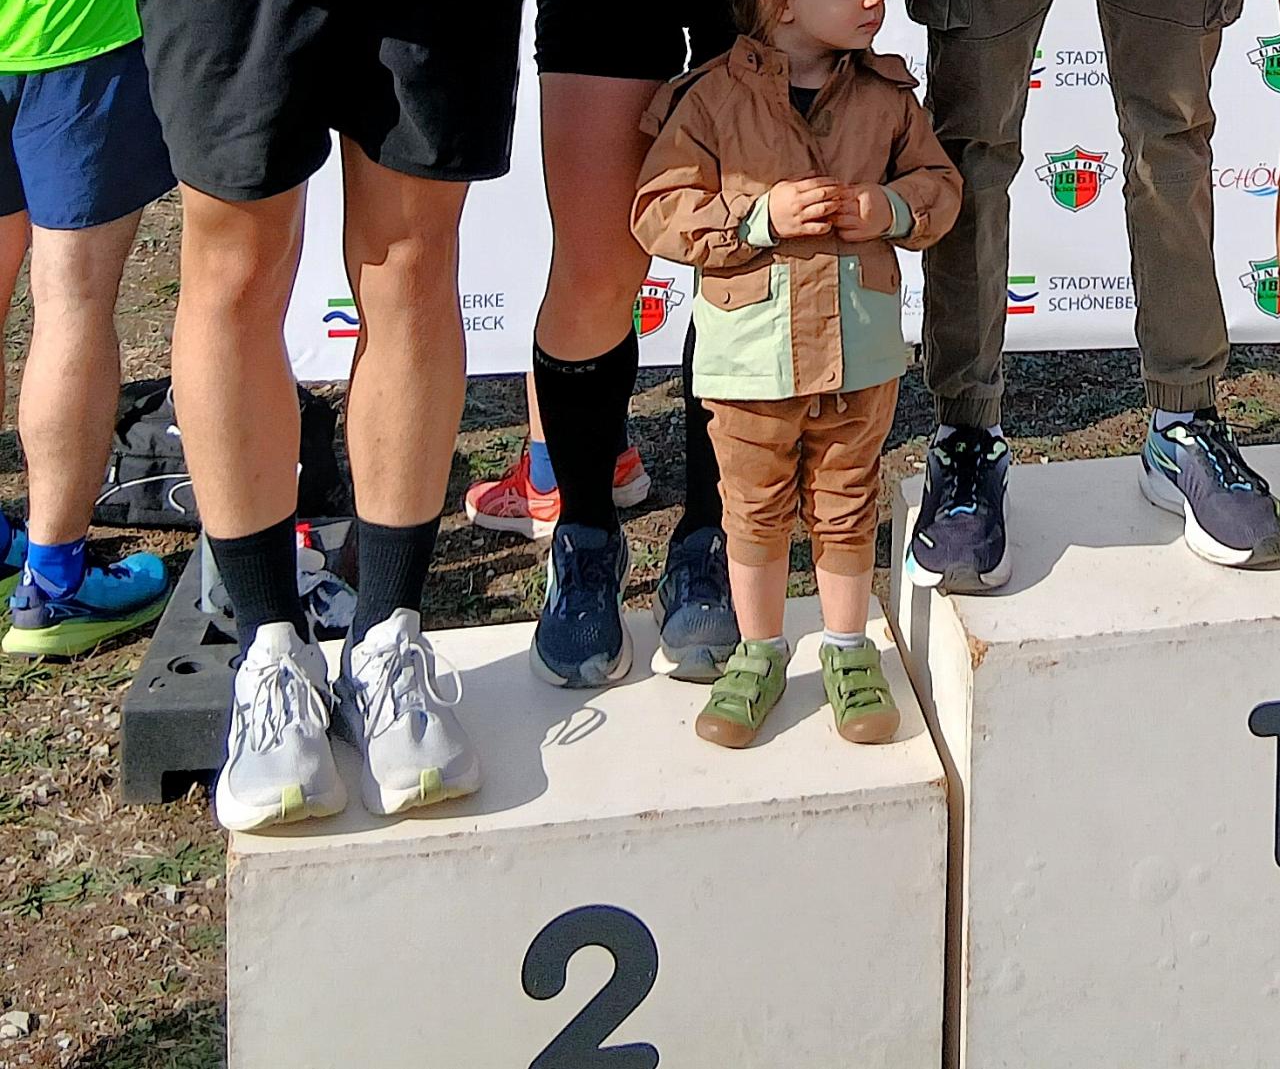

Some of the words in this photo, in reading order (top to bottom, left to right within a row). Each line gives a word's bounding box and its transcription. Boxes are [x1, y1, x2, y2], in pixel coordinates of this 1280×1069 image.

[1055, 50, 1105, 65] STADT
[1046, 159, 1107, 173] UNION
[1049, 276, 1134, 291] STADTWE
[1048, 294, 1136, 312] SCHÖNEBE
[521, 903, 660, 1069] 2
